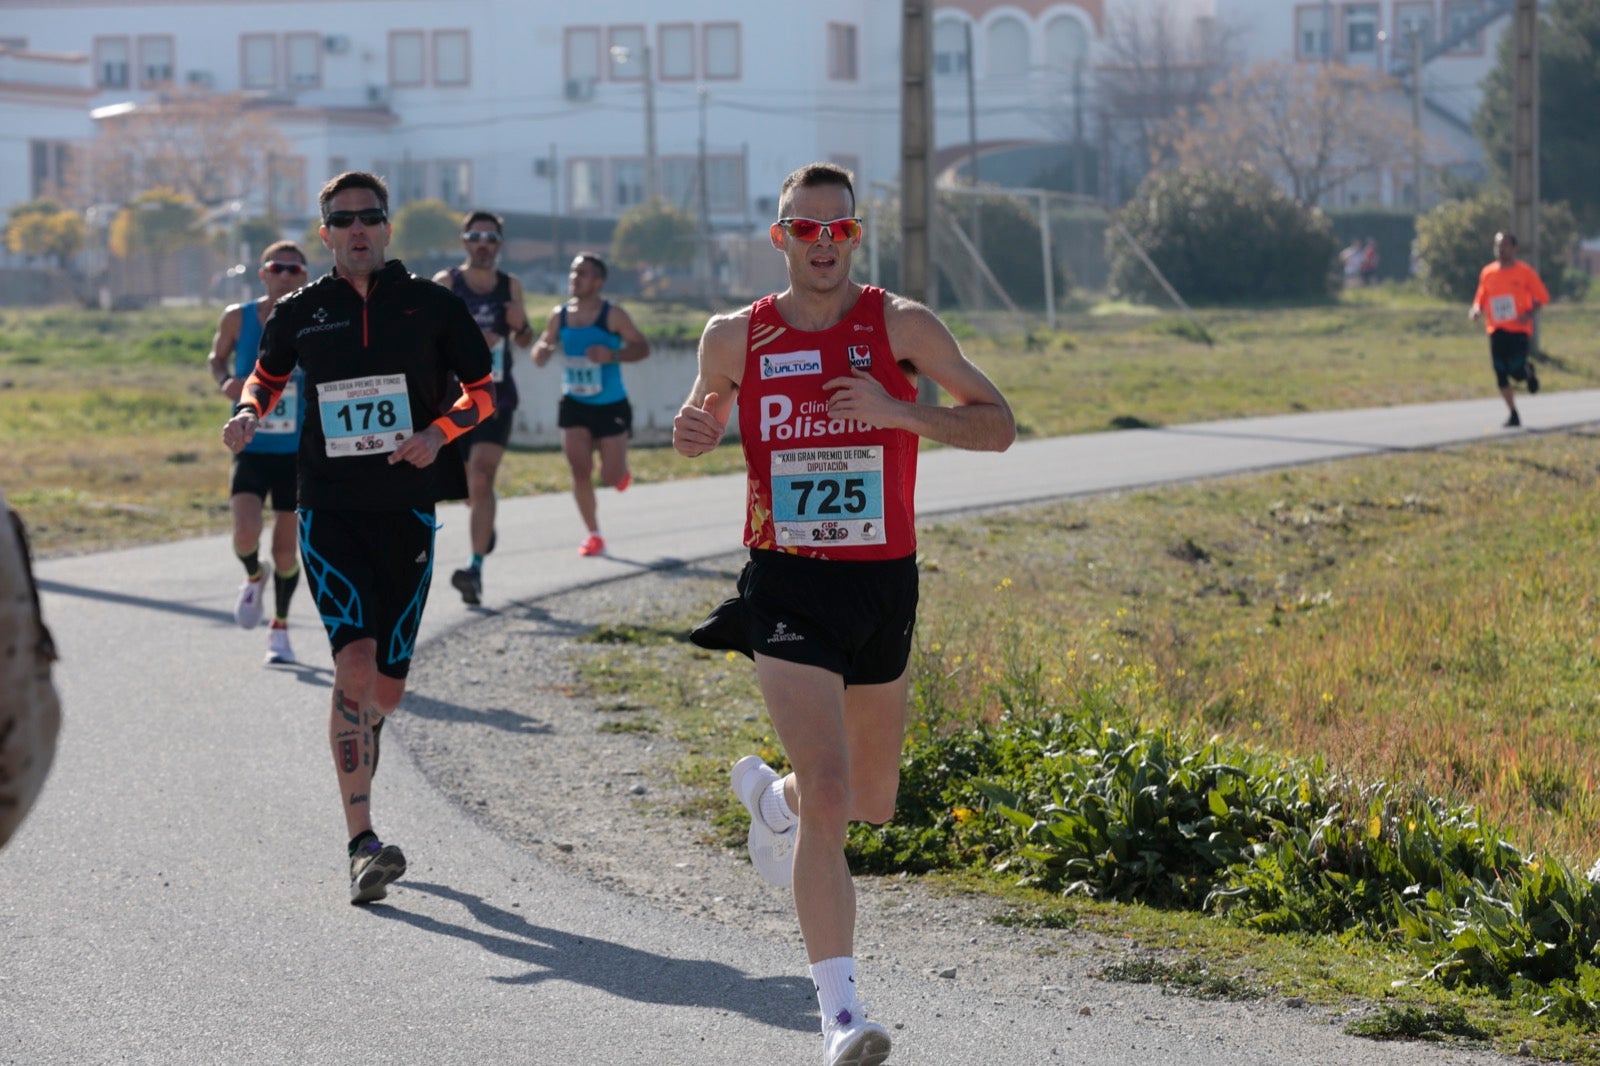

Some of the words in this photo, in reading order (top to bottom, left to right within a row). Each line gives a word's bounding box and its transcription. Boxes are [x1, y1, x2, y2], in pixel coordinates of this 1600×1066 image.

[337, 400, 397, 432] 178
[760, 394, 884, 442] Polisalu
[800, 401, 829, 415] Clíni
[797, 451, 816, 462] GRAN
[817, 450, 842, 461] PREMIO
[844, 449, 853, 460] DE
[807, 461, 848, 473] DIPUTACIÓN
[790, 478, 867, 516] 725
